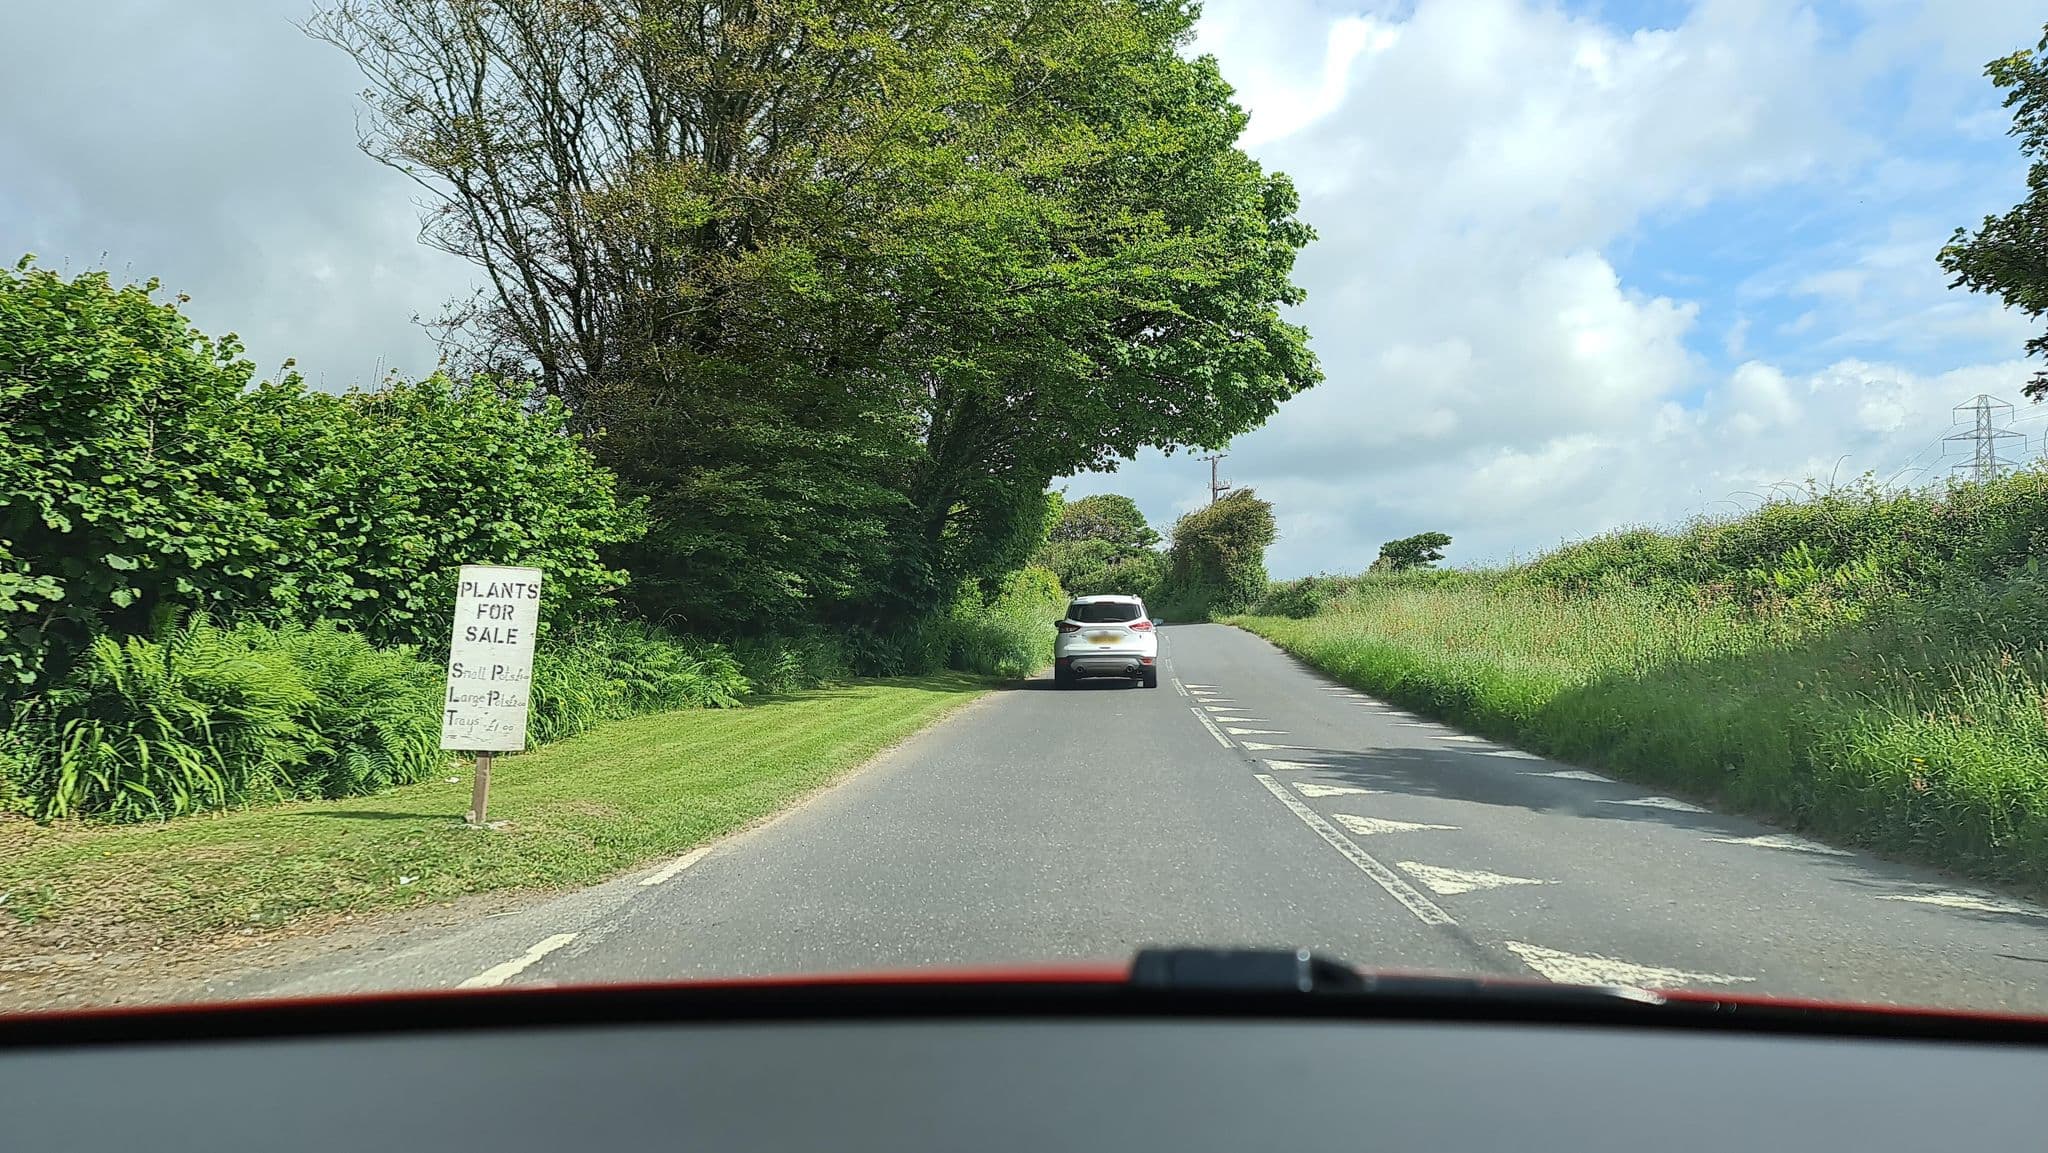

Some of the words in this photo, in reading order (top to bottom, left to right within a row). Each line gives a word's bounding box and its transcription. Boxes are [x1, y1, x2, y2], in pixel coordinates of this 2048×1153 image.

[460, 581, 539, 600] PLANTS
[476, 603, 515, 621] FOR
[465, 626, 519, 645] SALE
[449, 686, 486, 707] Large
[447, 710, 480, 733] Trays
